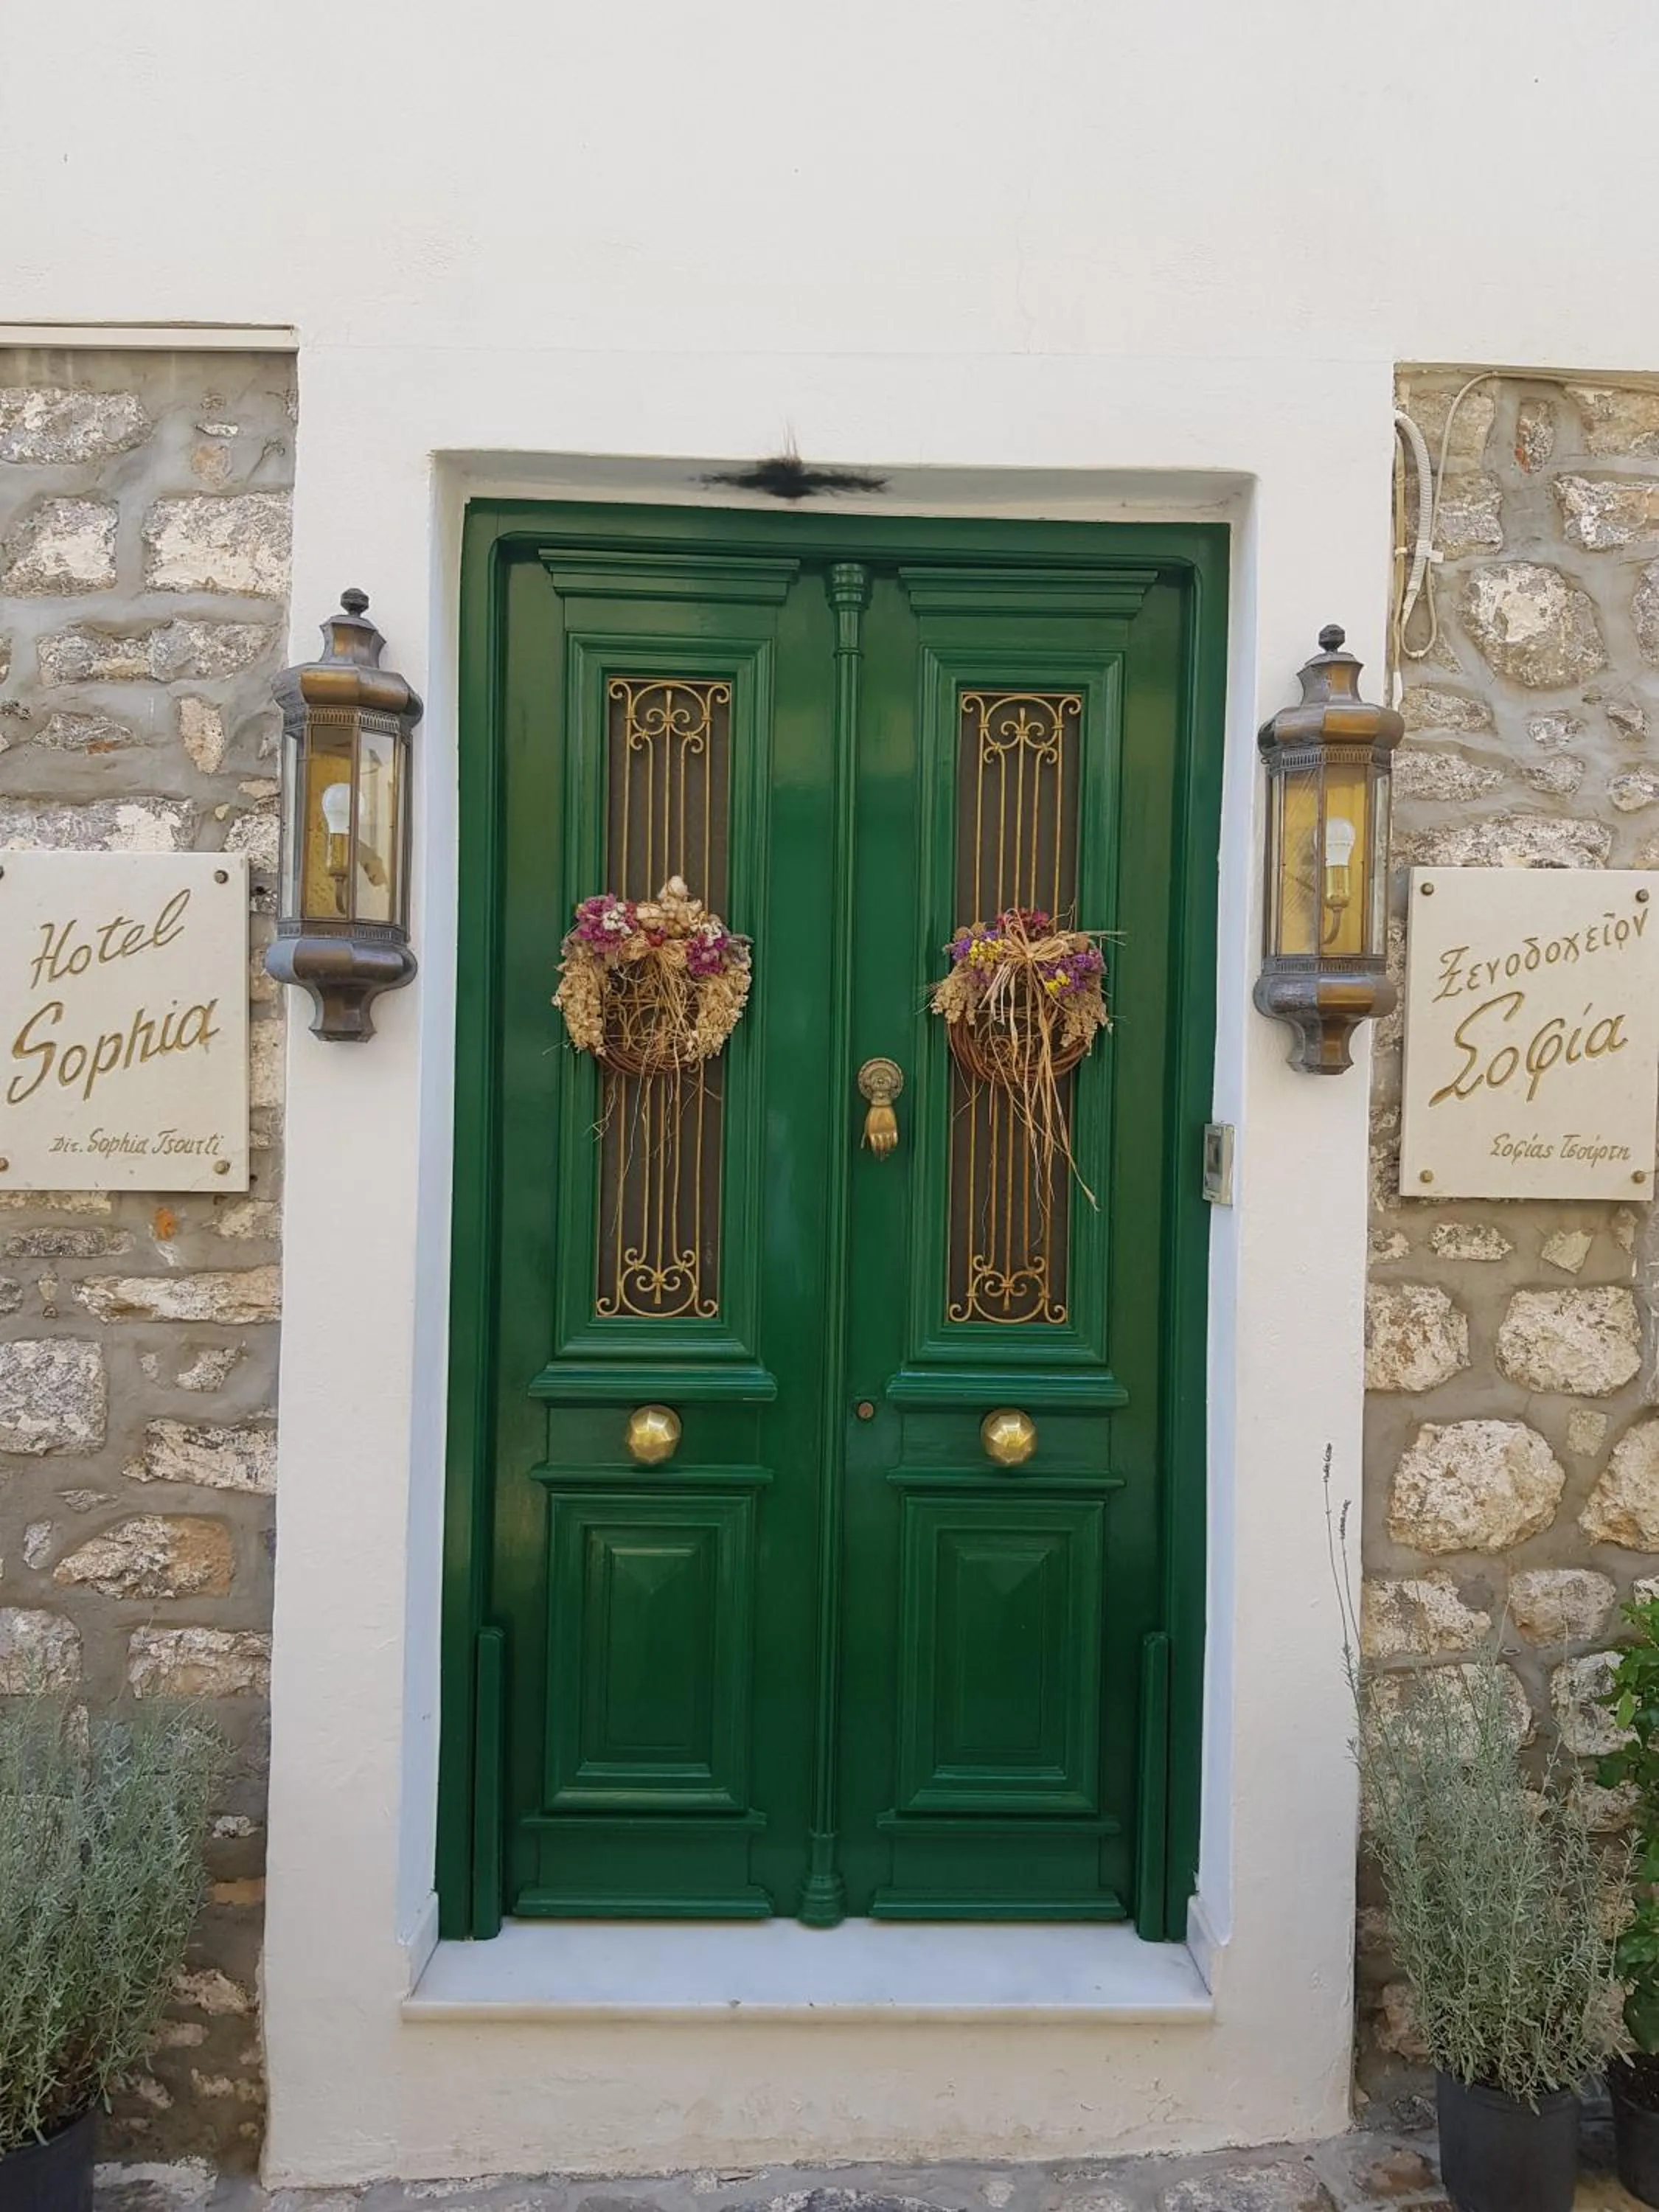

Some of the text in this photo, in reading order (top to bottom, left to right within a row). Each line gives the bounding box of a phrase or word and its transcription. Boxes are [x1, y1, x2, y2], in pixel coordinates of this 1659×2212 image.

[30, 888, 191, 990] Hotel
[7, 998, 220, 1105] Sophia
[1428, 990, 1628, 1107] Σοφία
[86, 1127, 150, 1158] Sophia
